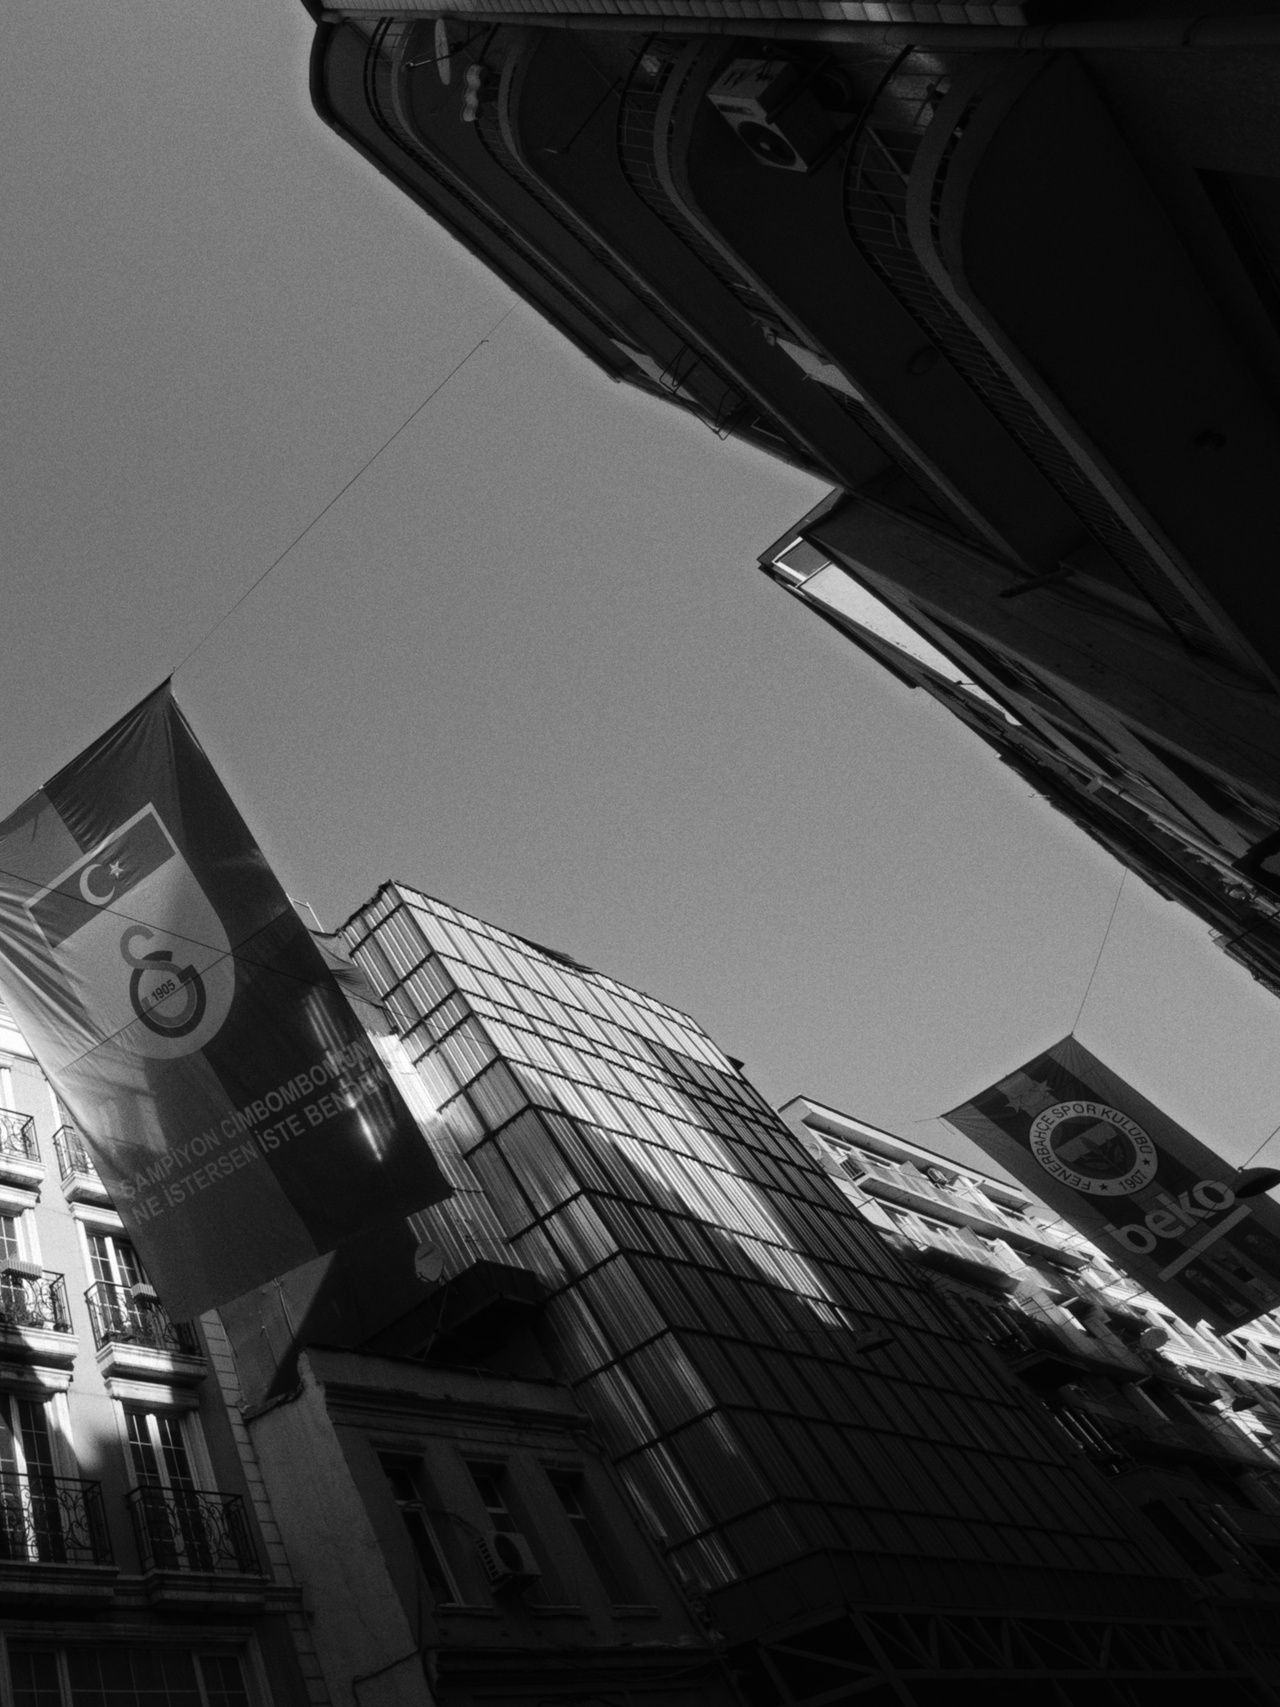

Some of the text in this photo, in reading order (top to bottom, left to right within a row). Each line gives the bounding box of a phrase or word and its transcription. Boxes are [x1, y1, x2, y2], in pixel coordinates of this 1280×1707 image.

[151, 979, 176, 1001] 1905
[1052, 1103, 1097, 1119] SPOR
[120, 1127, 221, 1201] ŞAMPİYON
[131, 1193, 163, 1226] NE
[162, 1140, 259, 1208] İSTERSEN
[255, 1113, 306, 1154] İSTE
[1033, 1115, 1092, 1191] FENERBAHÇE
[1118, 1169, 1148, 1191] 1907
[1103, 1179, 1236, 1254] beko
